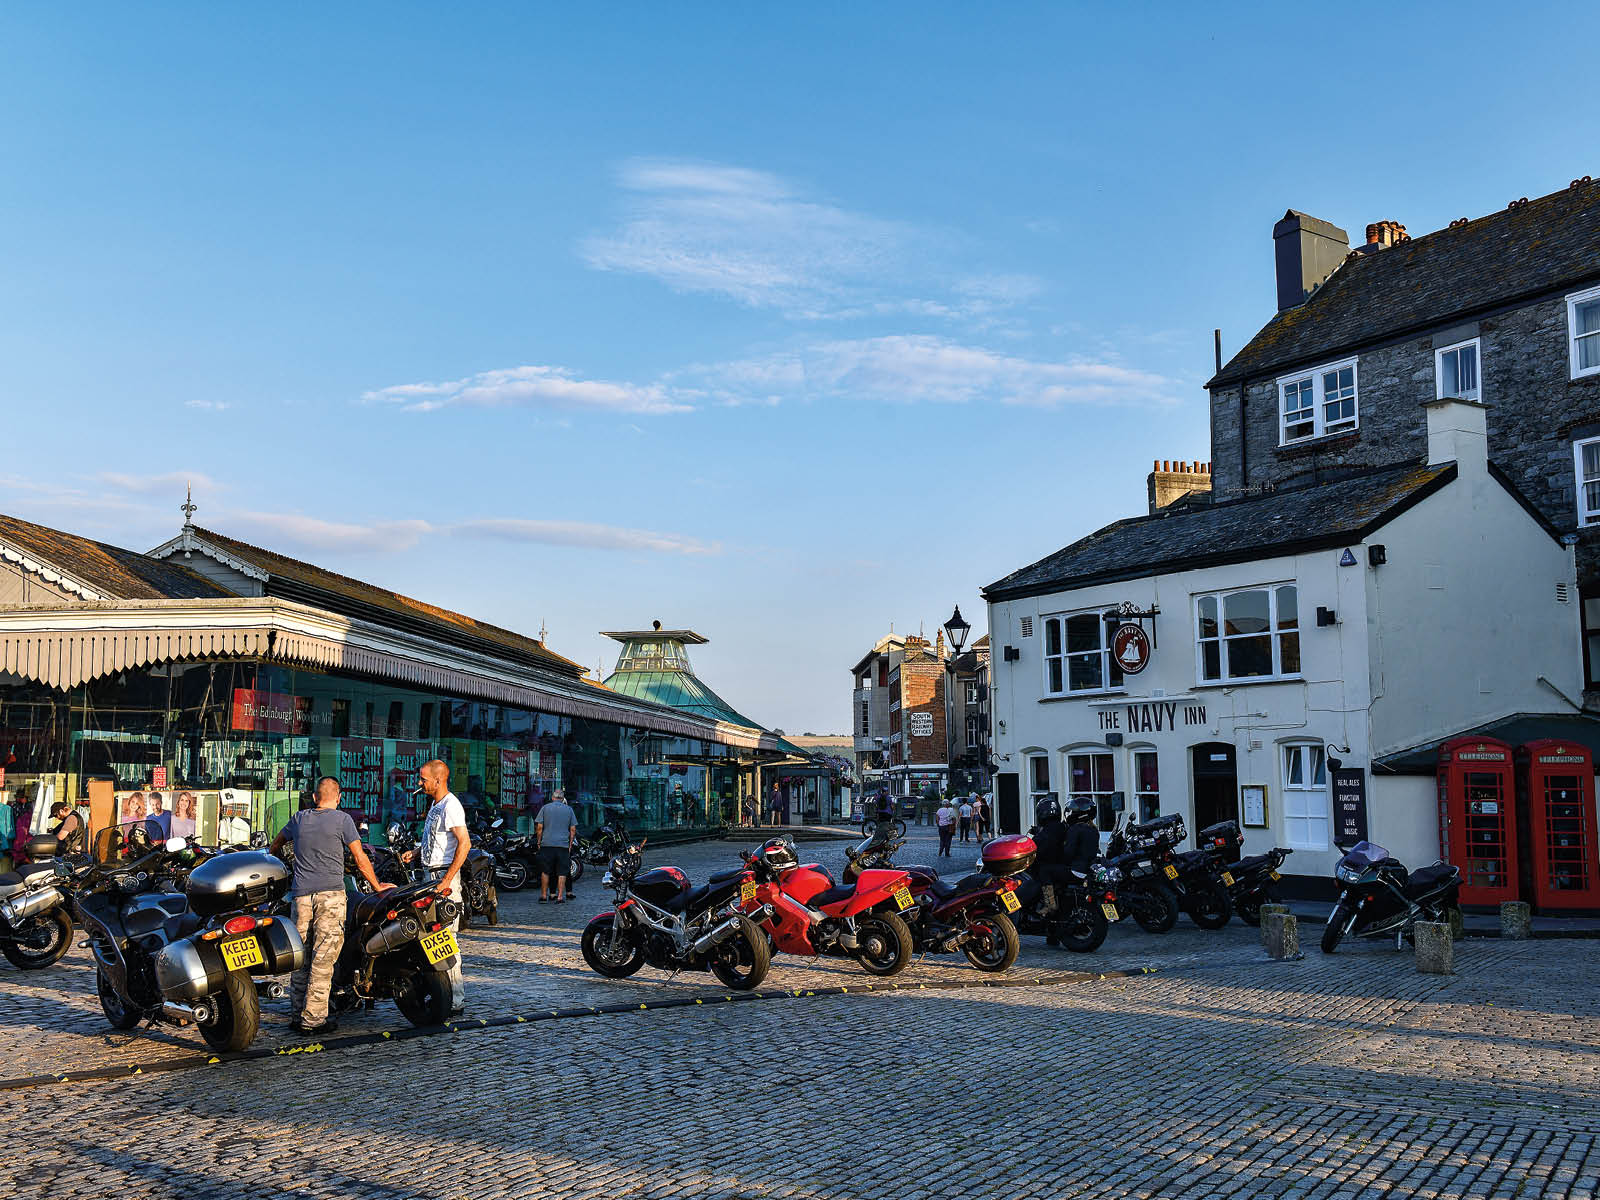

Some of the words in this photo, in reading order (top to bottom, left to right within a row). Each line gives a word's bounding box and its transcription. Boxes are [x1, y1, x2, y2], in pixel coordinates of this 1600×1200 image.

[244, 703, 258, 717] The
[1098, 711, 1120, 729] THE
[1127, 702, 1177, 733] NAVY
[1184, 706, 1207, 725] INN
[341, 750, 362, 769] SALE
[364, 746, 382, 766] SALE
[396, 755, 415, 771] SALE
[503, 760, 516, 776] SALE
[341, 771, 362, 789] SALE
[503, 775, 516, 791] SALE
[341, 791, 361, 809] SALE
[503, 791, 516, 806] SALE
[1345, 818, 1355, 826] LIVE
[224, 938, 256, 956] KE03
[423, 930, 450, 950] DX55
[232, 952, 257, 967] UFU
[432, 944, 454, 960] KHD
